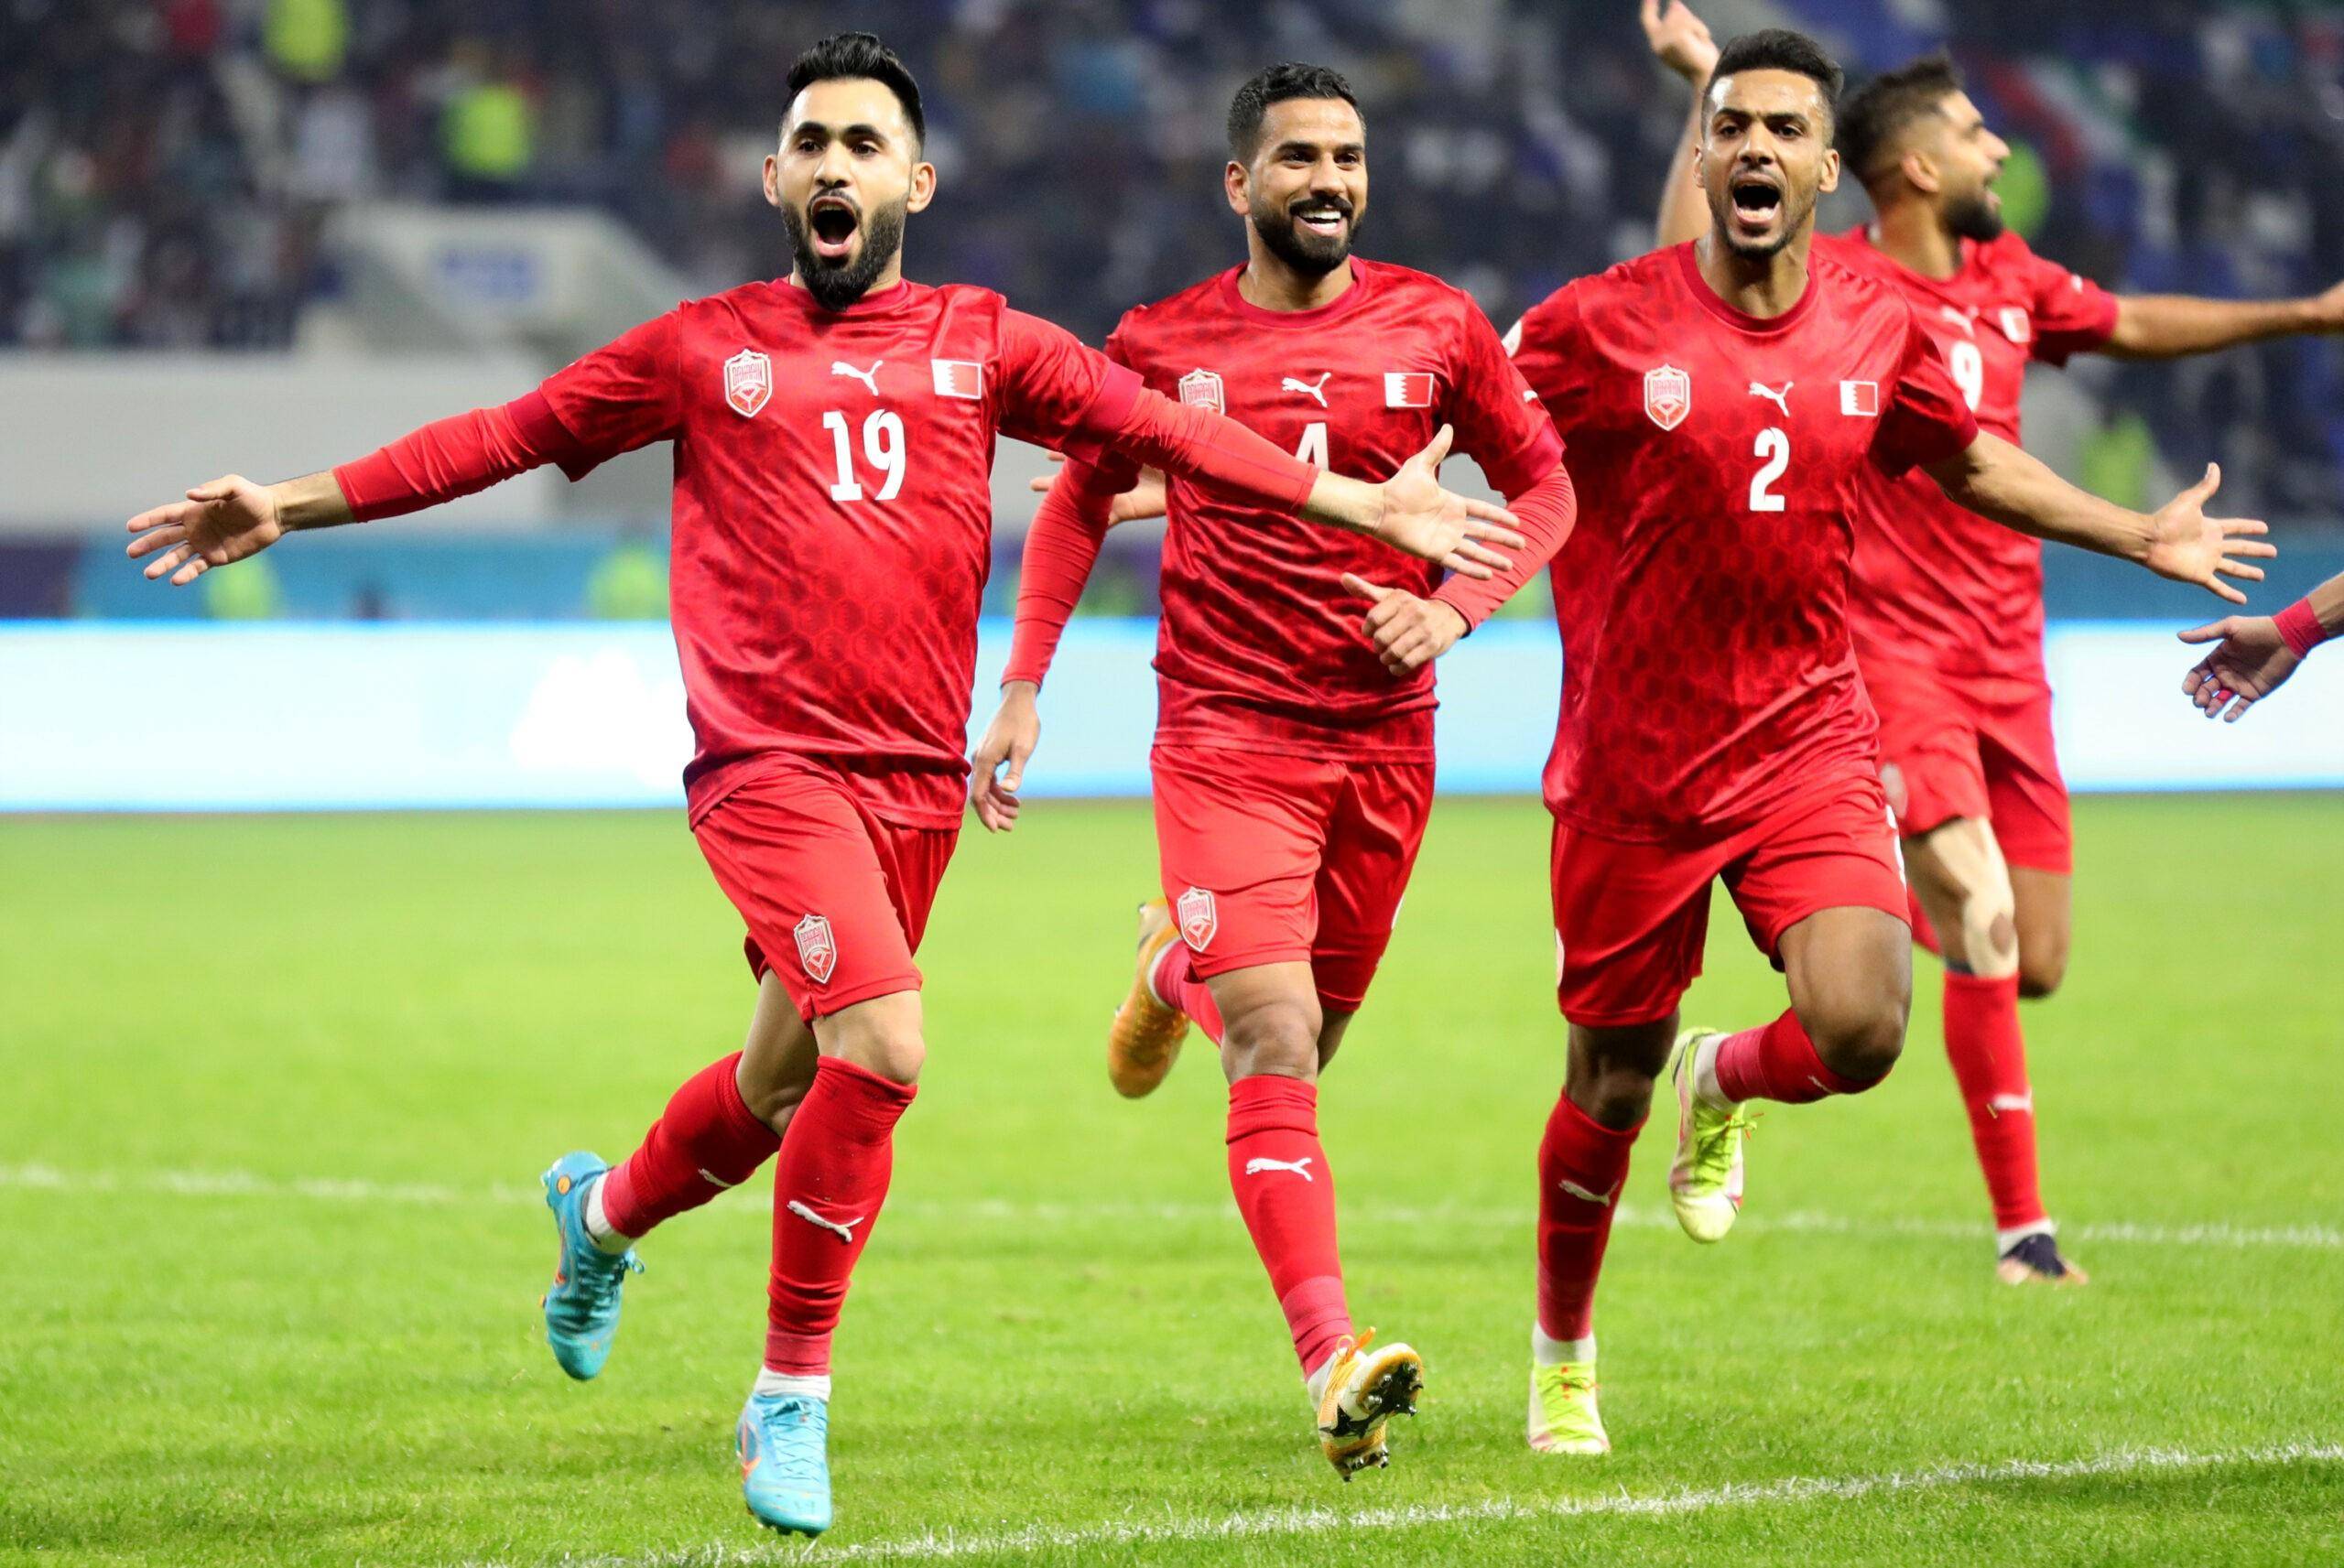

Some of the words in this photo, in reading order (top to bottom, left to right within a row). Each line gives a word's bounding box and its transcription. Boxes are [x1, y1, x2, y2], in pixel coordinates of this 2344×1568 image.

[1950, 341, 1982, 413] 9
[823, 408, 906, 502] 19
[1750, 427, 1790, 512] 2
